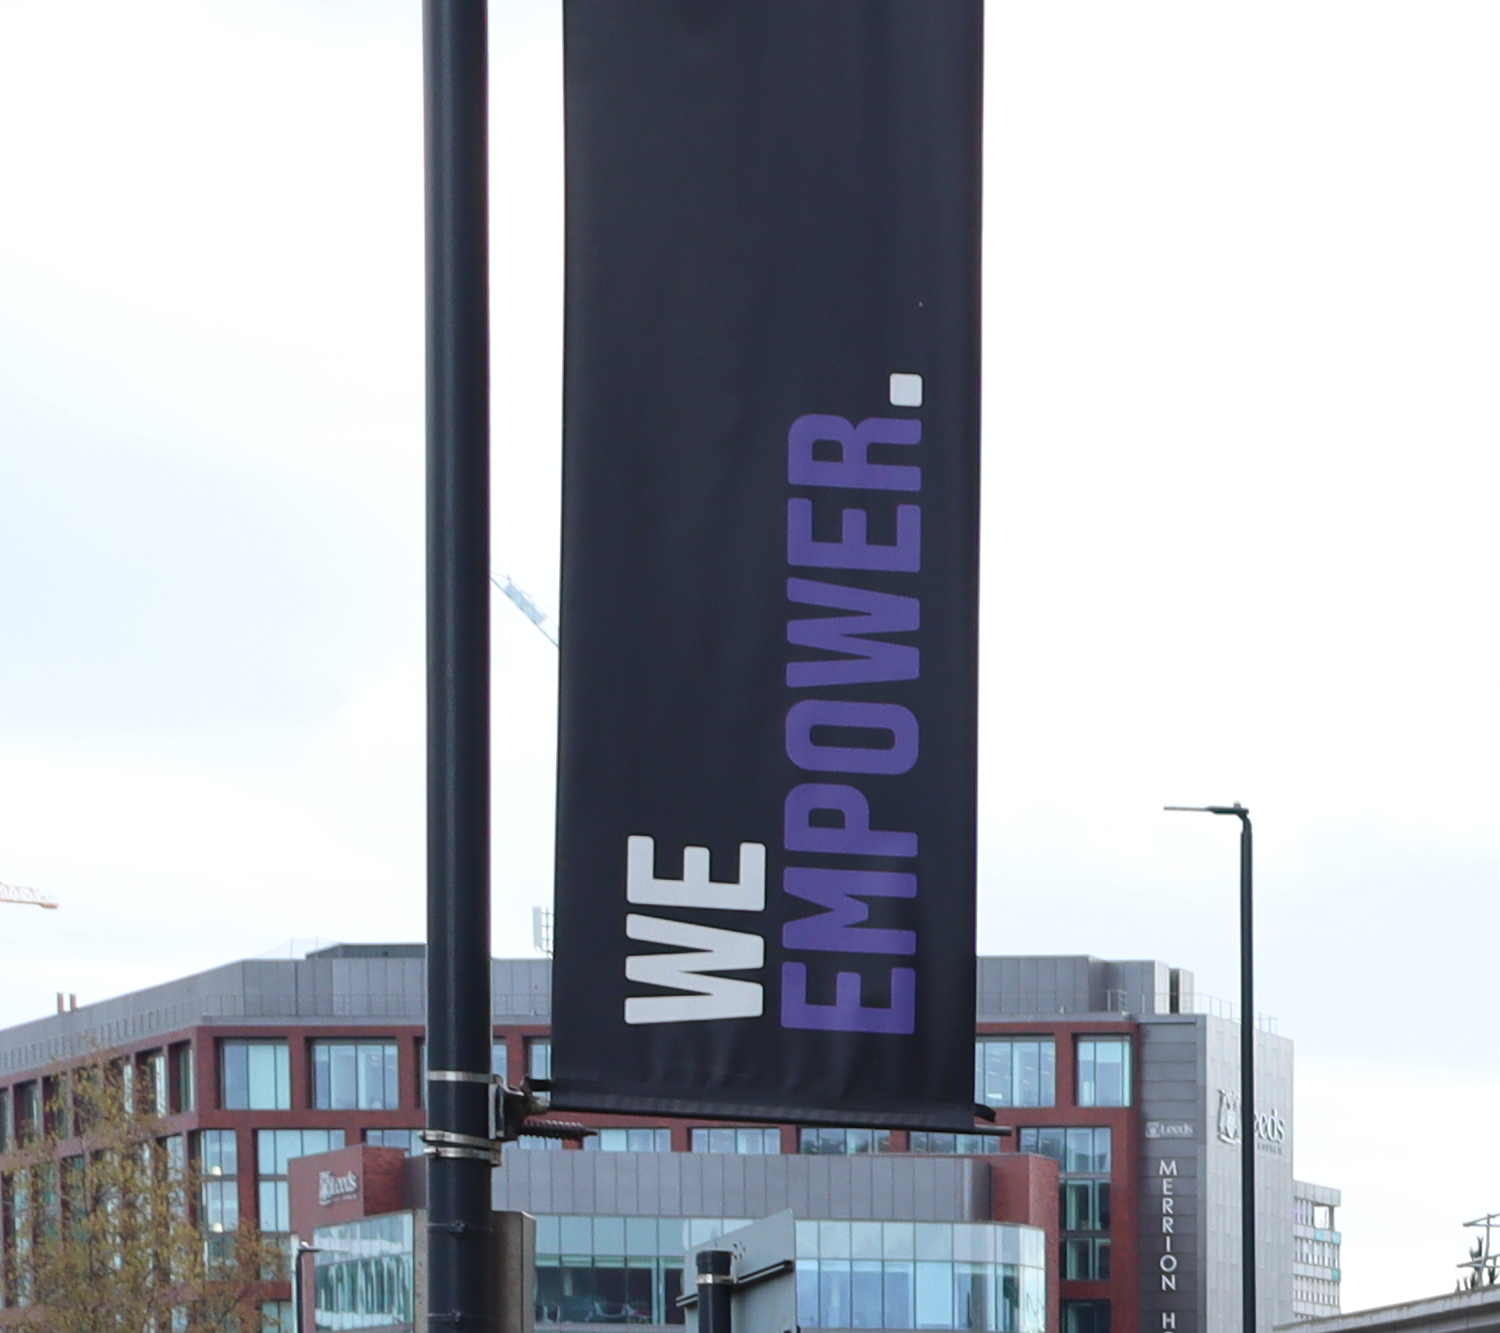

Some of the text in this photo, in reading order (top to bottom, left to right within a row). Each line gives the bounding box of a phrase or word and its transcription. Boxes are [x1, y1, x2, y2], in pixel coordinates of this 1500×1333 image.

[781, 373, 923, 1035] EMPOWER.
[624, 836, 766, 1025] WE
[1158, 1159, 1178, 1291] MERRION
